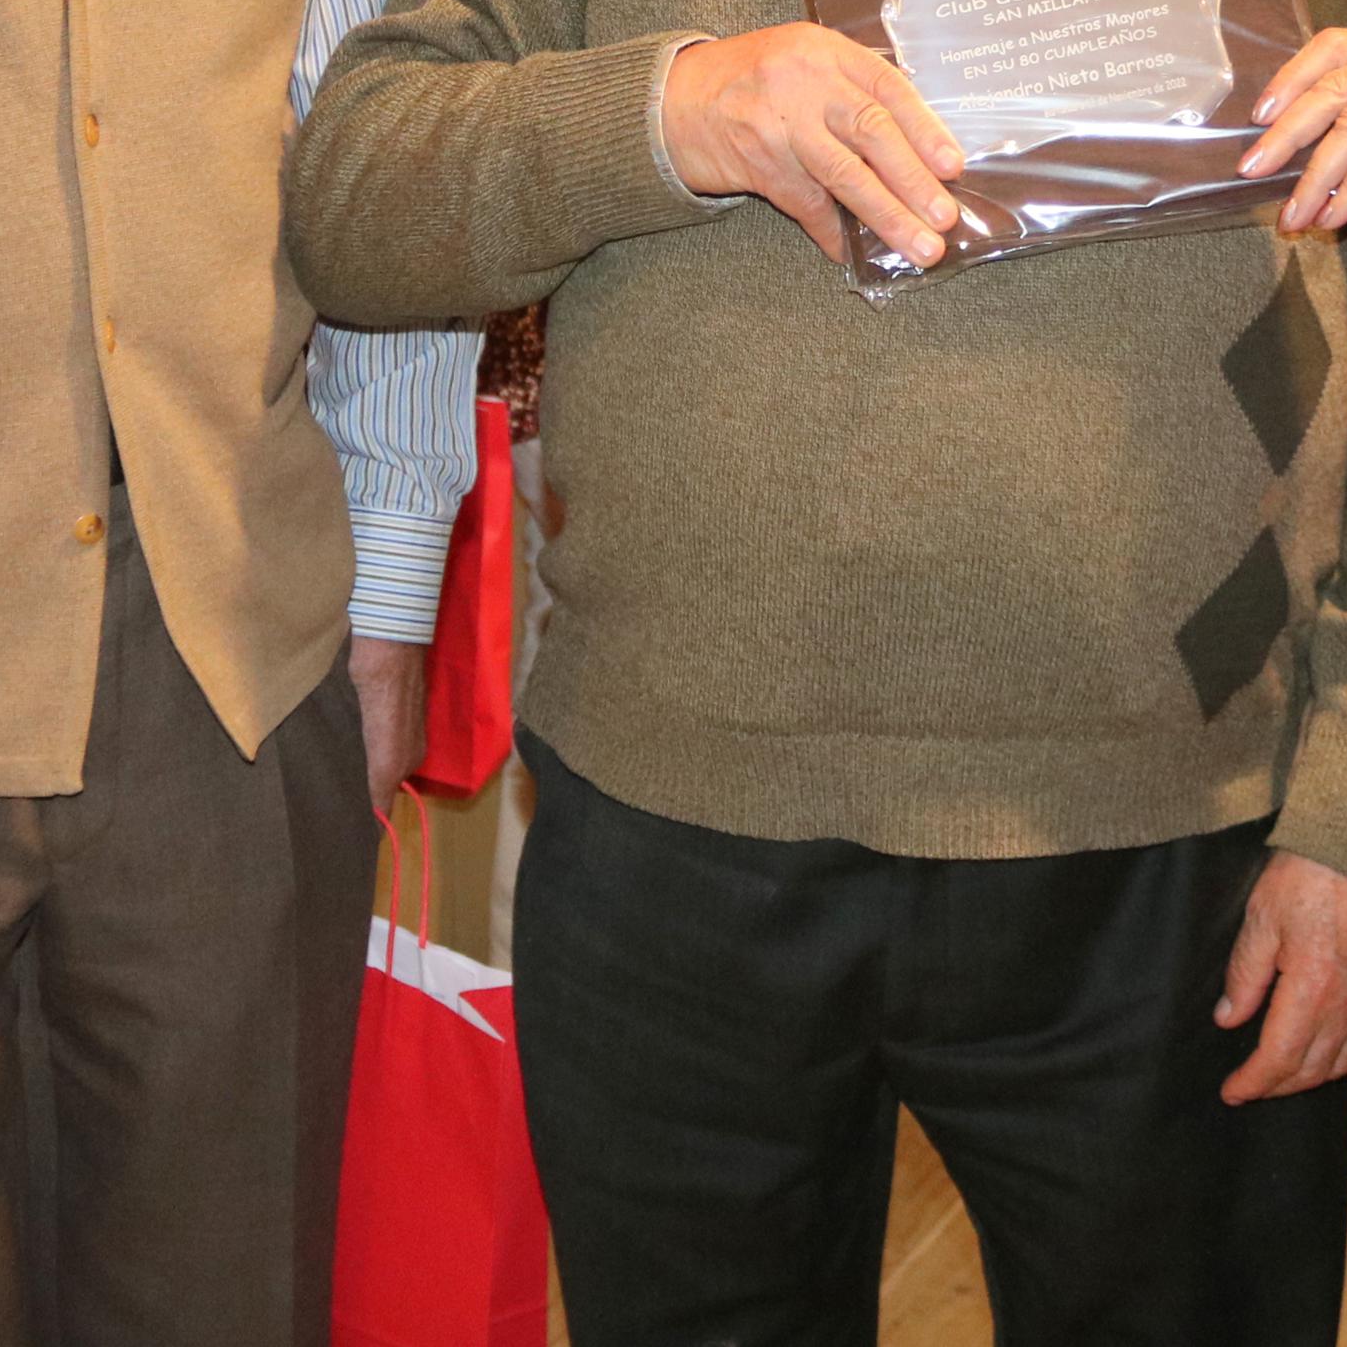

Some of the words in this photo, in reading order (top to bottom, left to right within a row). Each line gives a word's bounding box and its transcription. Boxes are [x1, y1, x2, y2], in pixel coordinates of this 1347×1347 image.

[940, 38, 1015, 65] Homenaje
[1018, 36, 1028, 47] a
[1030, 19, 1101, 45] Nuestros
[1105, 4, 1169, 28] Mayores
[983, 7, 1022, 26] SAN
[963, 64, 988, 80] EN
[992, 58, 1015, 73] SU
[1019, 52, 1040, 67] 80
[1044, 25, 1157, 60] CUMPLEAÑOS
[958, 81, 1044, 112] Alejandro
[1048, 69, 1099, 91] Nieto
[1104, 52, 1175, 78] Barroso
